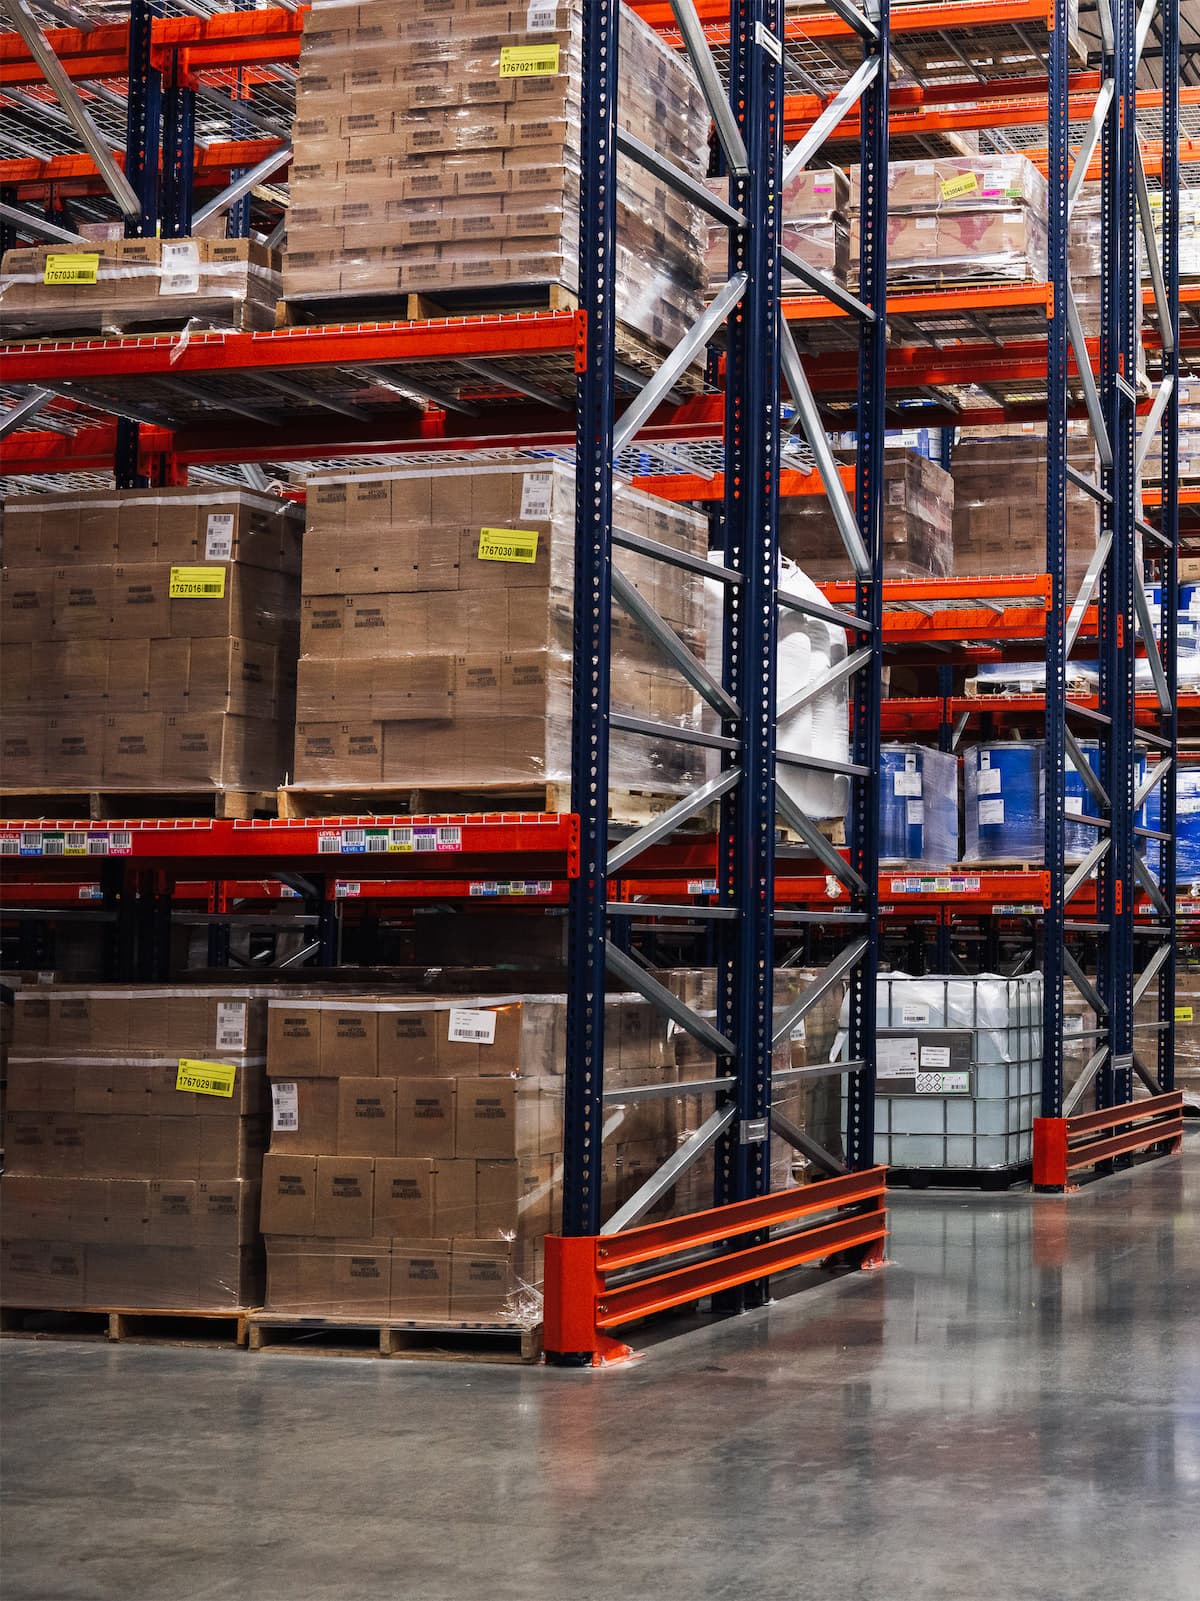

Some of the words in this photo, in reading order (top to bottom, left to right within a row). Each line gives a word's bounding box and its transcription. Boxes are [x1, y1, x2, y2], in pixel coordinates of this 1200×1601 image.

[502, 62, 534, 73] 1767021
[47, 271, 75, 280] 1767033
[480, 545, 512, 556] 1767030
[171, 584, 202, 593] 1767016
[179, 1076, 210, 1089] 1767029
